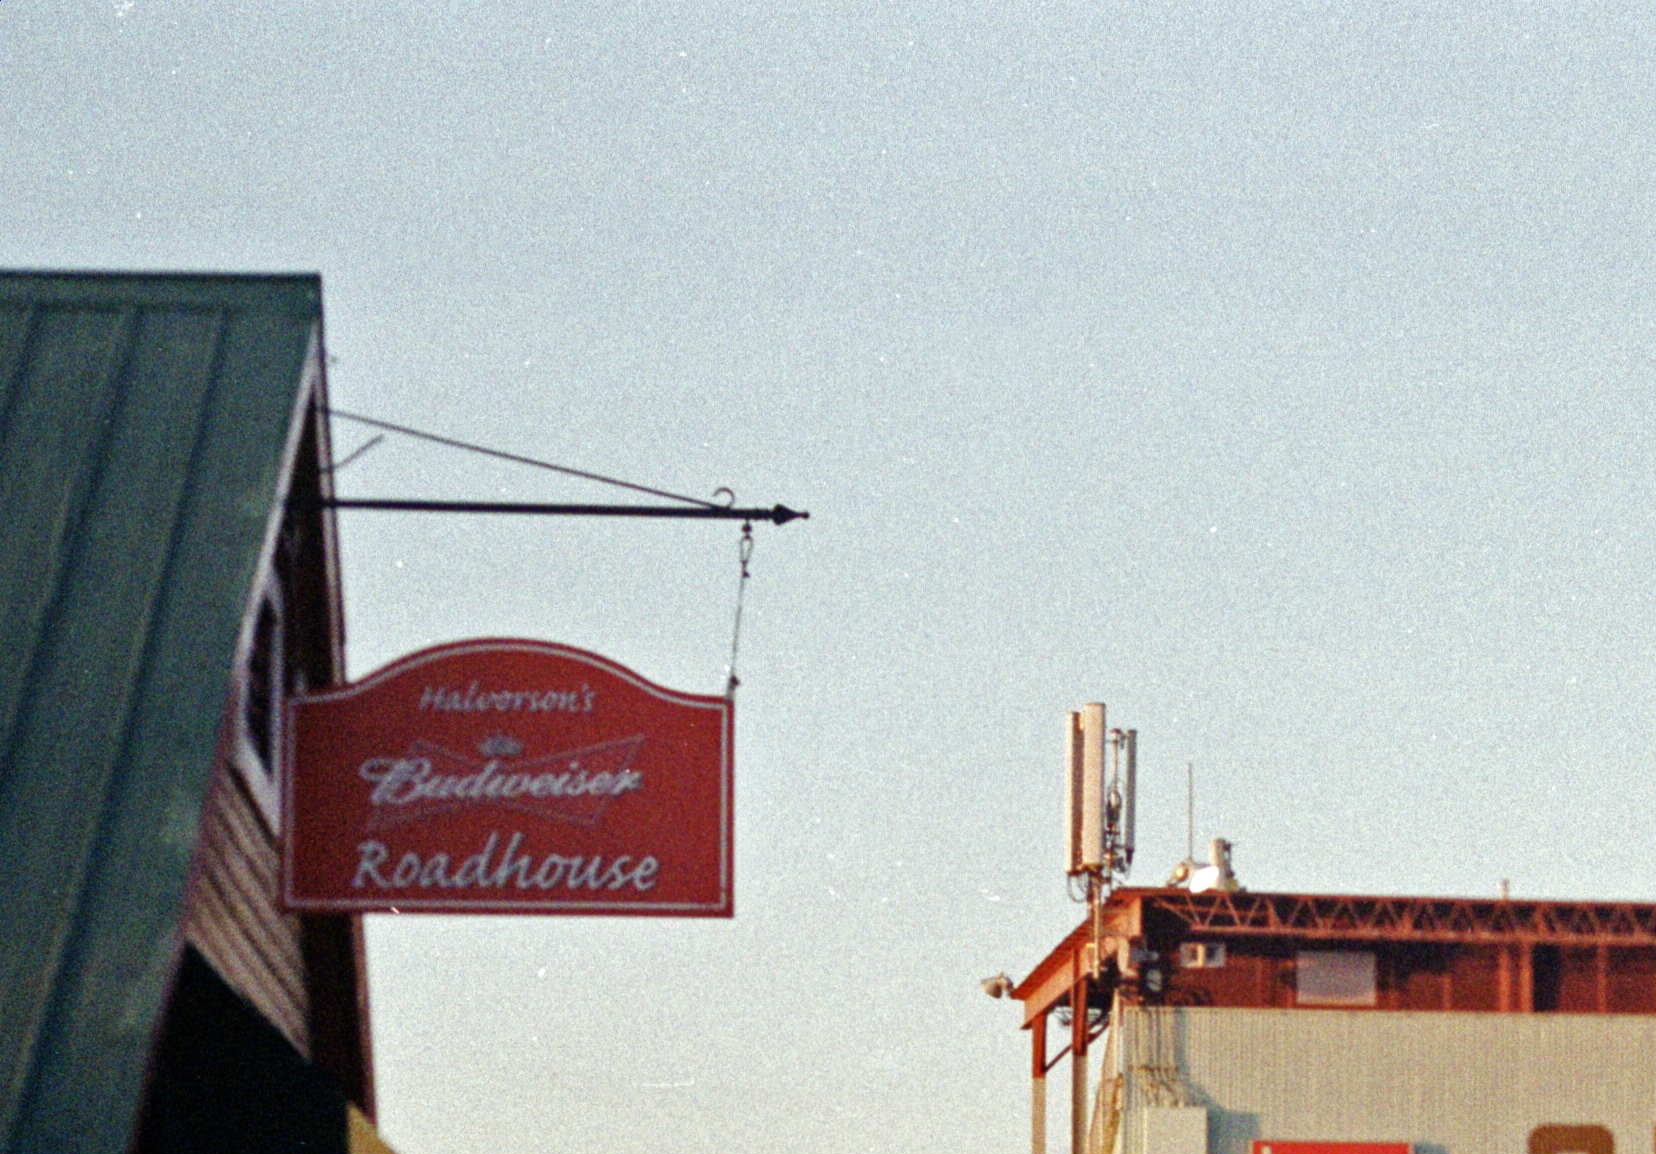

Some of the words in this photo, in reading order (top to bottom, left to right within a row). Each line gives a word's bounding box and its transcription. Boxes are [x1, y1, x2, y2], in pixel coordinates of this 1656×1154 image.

[418, 680, 596, 713] Halvorson's
[358, 757, 643, 804] Budweiser
[351, 832, 659, 891] Roadhouse
